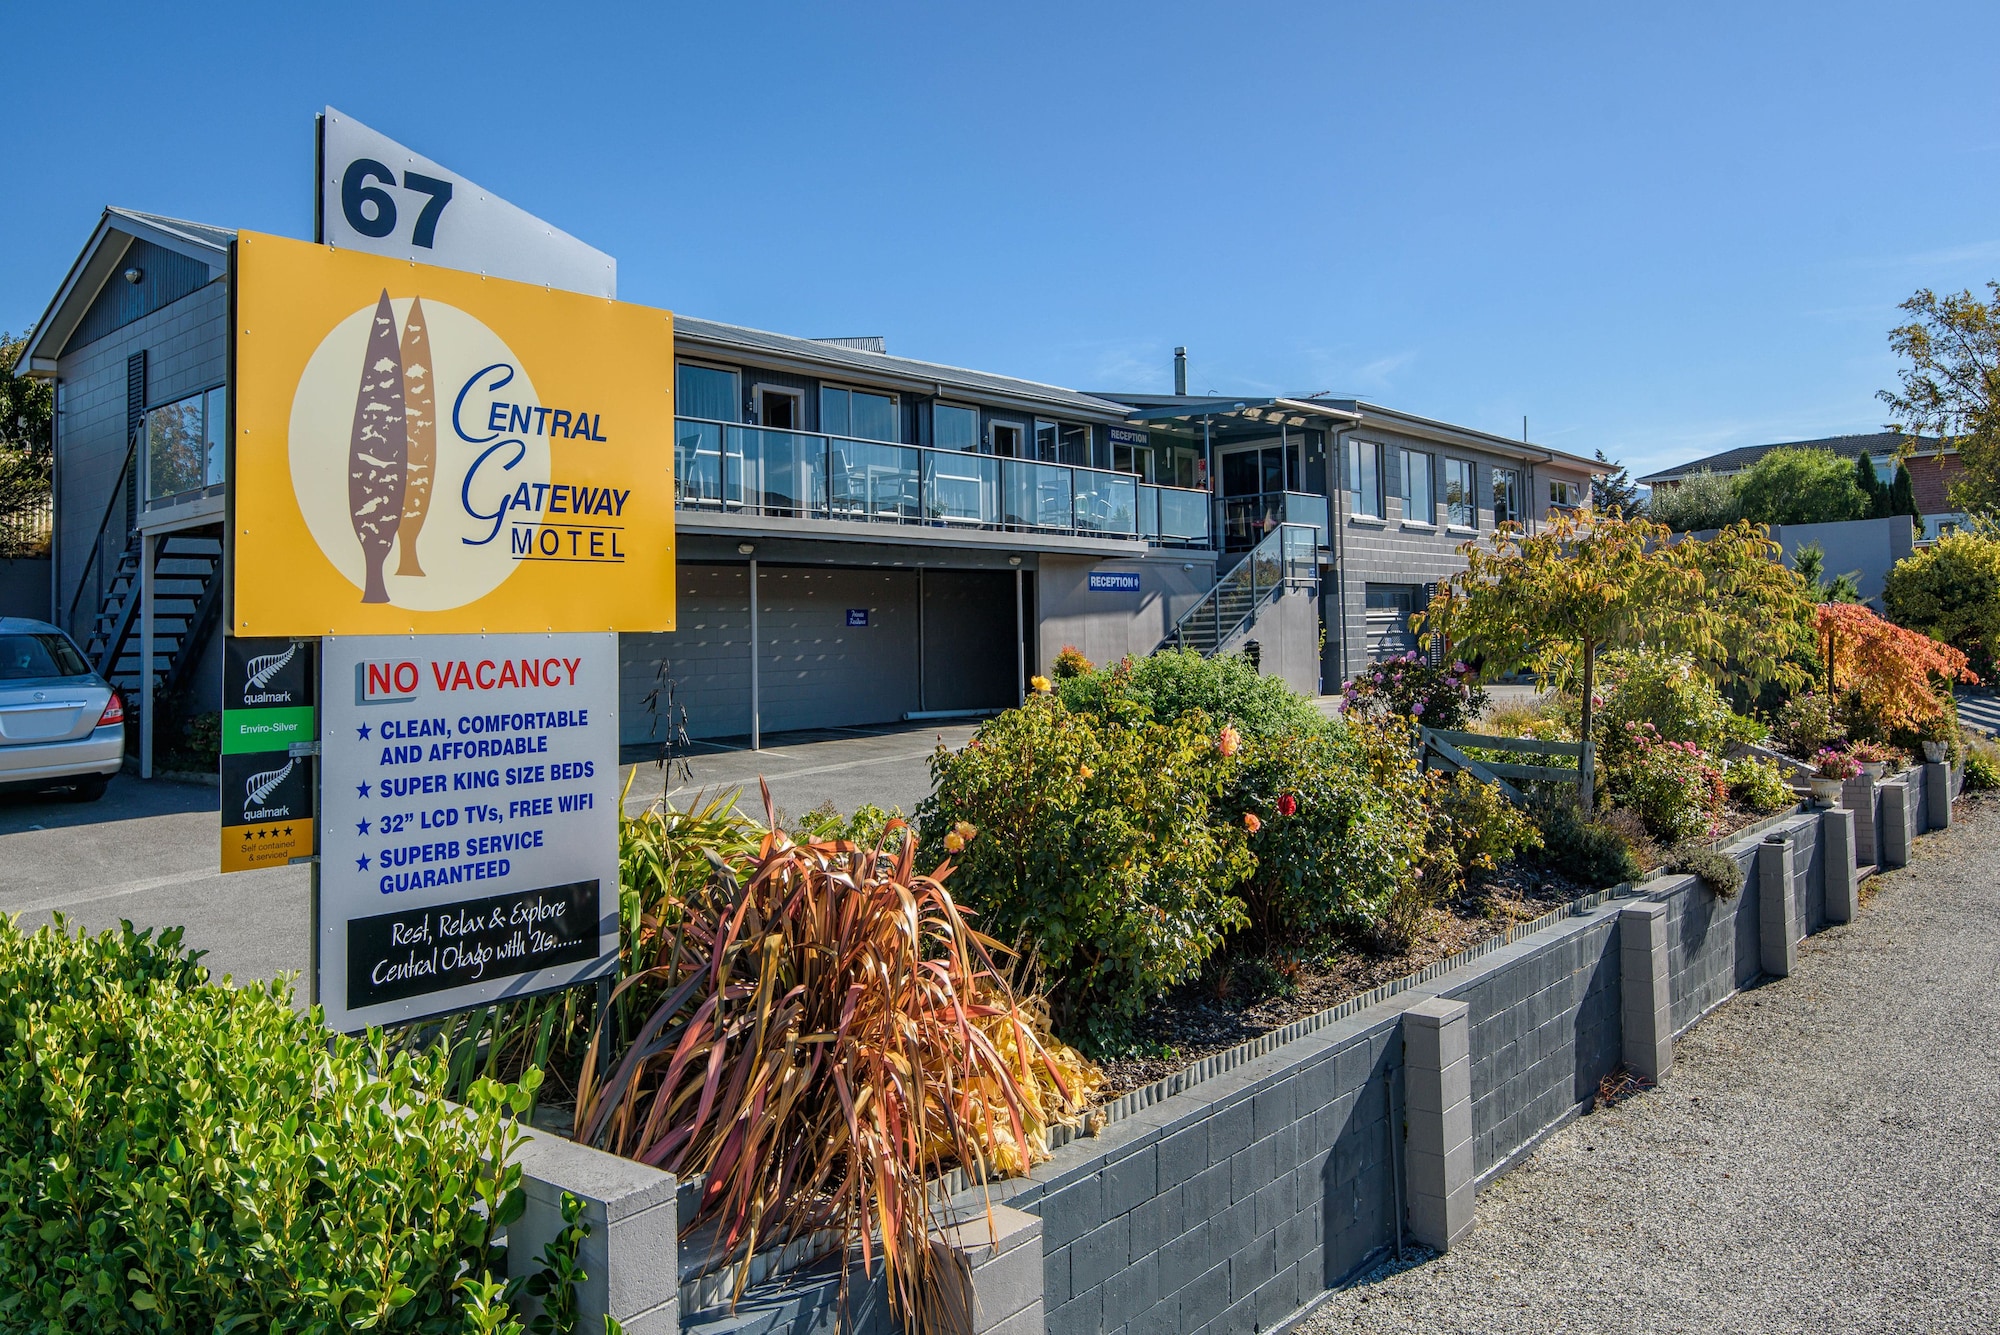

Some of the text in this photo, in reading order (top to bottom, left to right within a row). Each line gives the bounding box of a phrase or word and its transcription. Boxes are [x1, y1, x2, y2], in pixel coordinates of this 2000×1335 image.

[341, 158, 453, 249] 67
[452, 363, 608, 444] CENTRAL
[1110, 429, 1147, 444] RECEPTION
[461, 439, 631, 545] GATEWAY
[512, 526, 626, 558] MOTEL
[1090, 576, 1134, 588] RECEPTION
[368, 658, 582, 694] NO VACANCY
[243, 691, 291, 705] qualmark
[240, 722, 298, 734] Enviro-Silver
[380, 709, 588, 740] CLEAN, COMFORTABLE
[380, 735, 548, 766] AND AFFORDABLE
[380, 760, 594, 798] SUPER KING SIZE BEDS
[243, 805, 290, 821] qualmark
[421, 807, 459, 830] LCD
[464, 804, 503, 825] TVs,
[509, 797, 553, 819] FREE
[558, 793, 593, 812] WIFI
[241, 839, 296, 853] Self contained
[248, 850, 288, 862] & serviced
[380, 830, 543, 869] SUPERB SERVICE
[380, 859, 510, 895] GUARANTEED
[392, 895, 566, 947] Rest, Relax & Explore
[371, 947, 438, 985] Central
[441, 940, 493, 979] Otago
[496, 931, 526, 960] with
